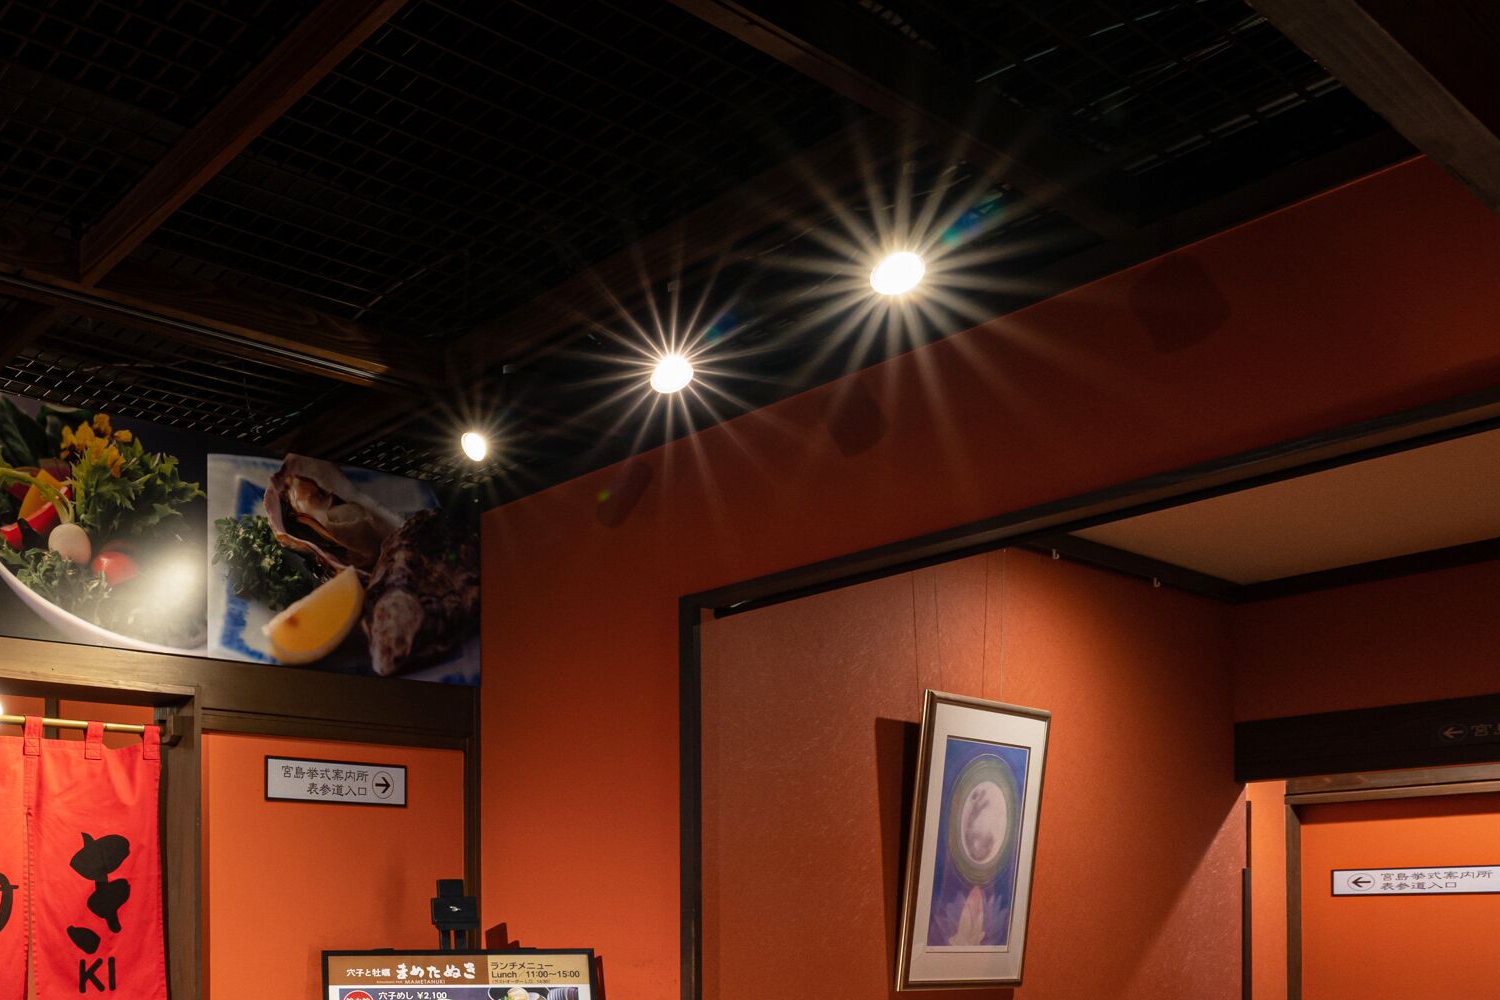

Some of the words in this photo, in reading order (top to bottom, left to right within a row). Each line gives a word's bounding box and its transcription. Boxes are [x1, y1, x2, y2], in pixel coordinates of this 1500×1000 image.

[281, 765, 369, 783] 宮島挙式案内所
[306, 782, 368, 797] 表参道入口
[1380, 881, 1458, 891] 表参道入口
[396, 962, 476, 980] まめたぬき
[491, 962, 554, 970] ランチメニュー
[78, 957, 117, 993] KI
[491, 971, 517, 979] Lunch
[378, 992, 414, 1000] 穴子めし
[417, 992, 448, 1000] ¥2,100
